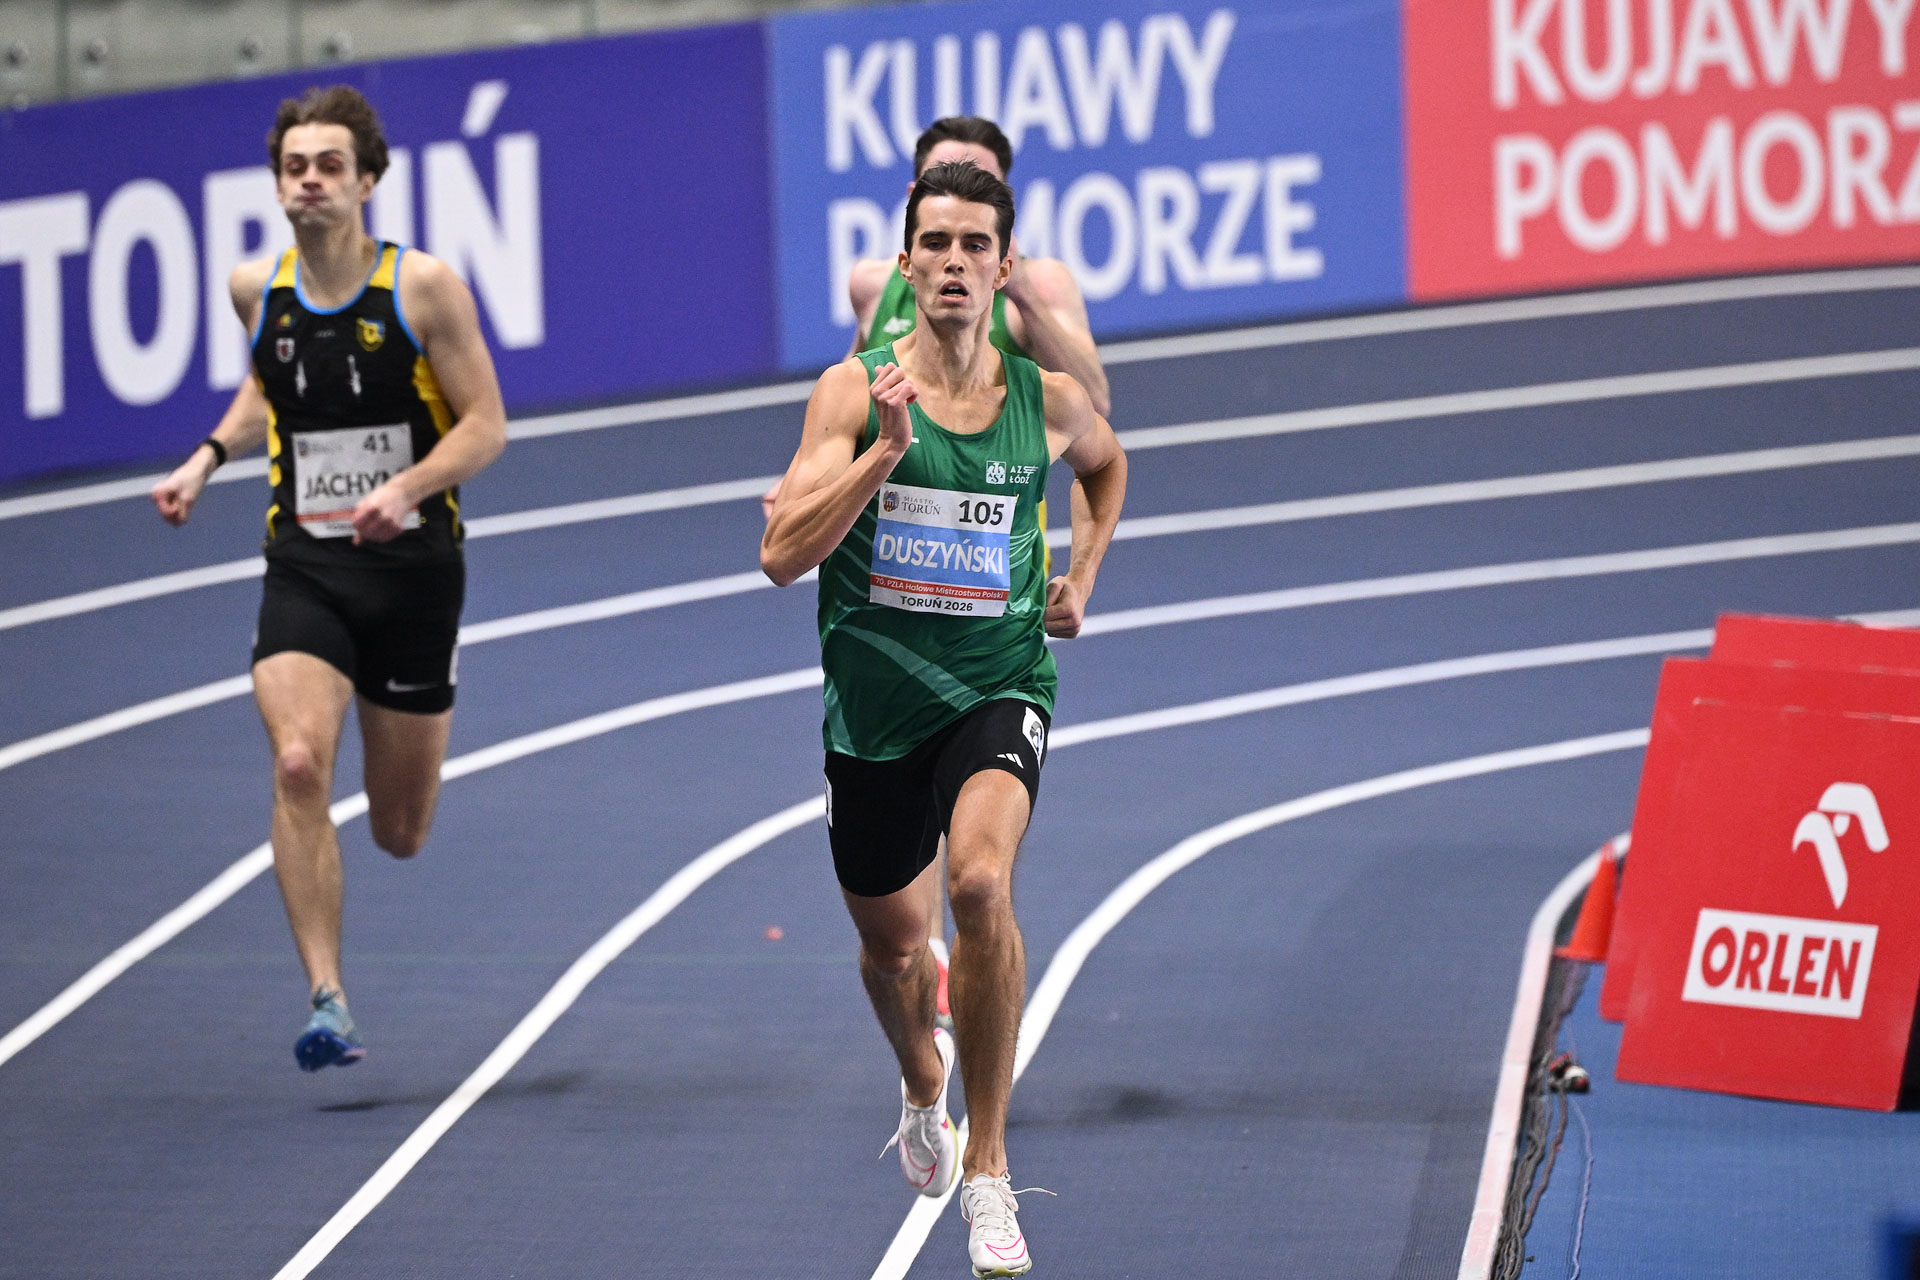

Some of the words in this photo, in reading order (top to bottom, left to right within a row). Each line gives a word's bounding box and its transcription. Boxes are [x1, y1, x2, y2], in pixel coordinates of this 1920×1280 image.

[1490, 0, 1920, 109] KUJAWY
[363, 432, 392, 453] 41
[901, 501, 941, 515] TORUŃ
[903, 495, 934, 505] MIASTO
[958, 499, 1005, 526] 105
[878, 533, 1003, 574] DUSZYŃSKI
[887, 579, 904, 589] PZLA
[905, 584, 934, 593] Halowe
[935, 587, 981, 598] Mistrzostwa
[981, 591, 1004, 600] Polski
[900, 595, 942, 609] TORUŃ
[944, 600, 973, 612] 2026
[1700, 926, 1863, 1001] ORLEN
